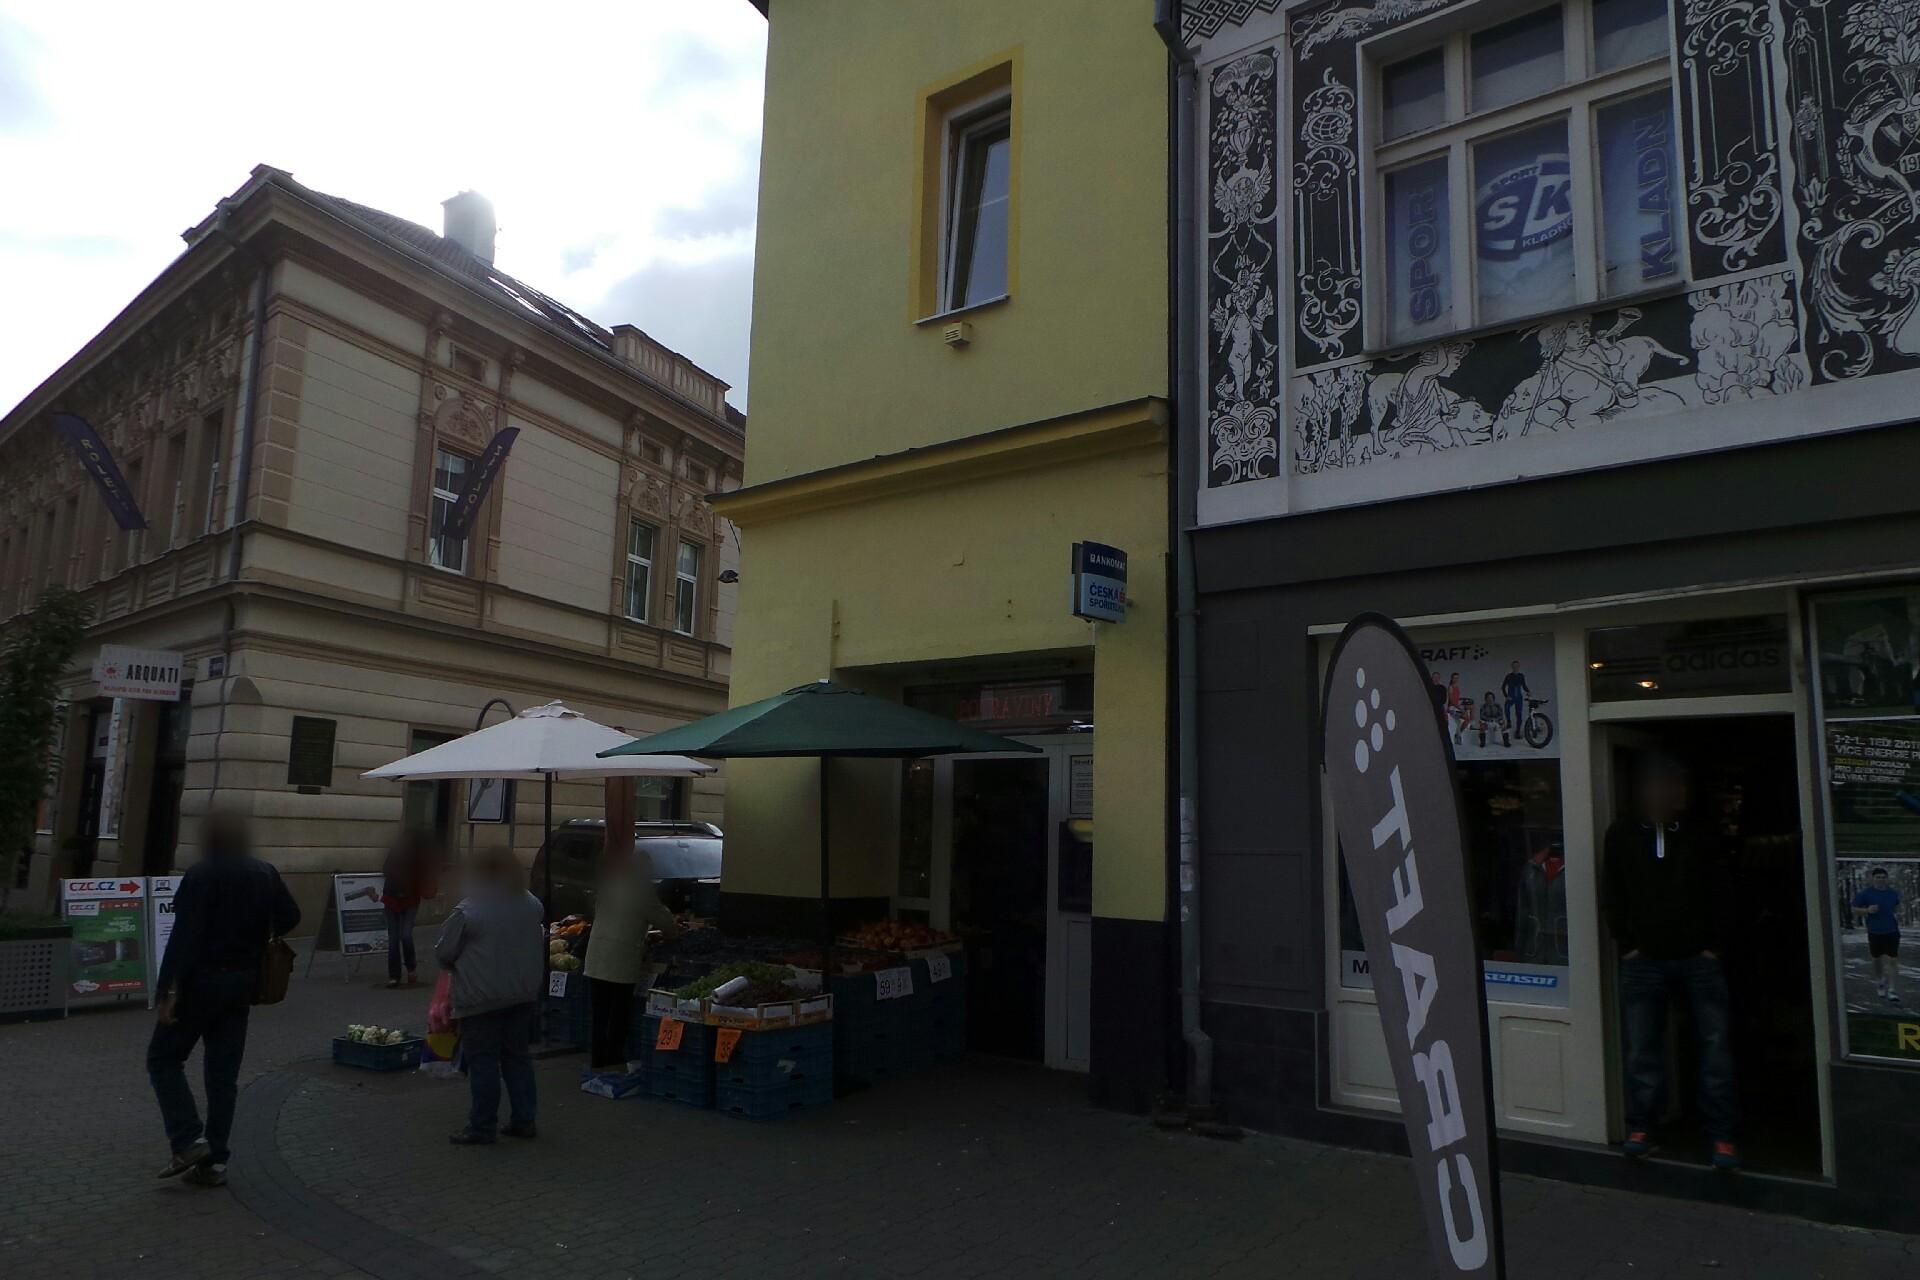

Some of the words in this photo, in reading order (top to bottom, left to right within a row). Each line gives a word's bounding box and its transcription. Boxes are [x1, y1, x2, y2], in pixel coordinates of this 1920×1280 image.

[1633, 110, 1674, 280] KLADN
[1408, 187, 1441, 324] SPOR
[1420, 645, 1471, 661] RAFT
[1666, 647, 1780, 673] adidas
[126, 664, 179, 683] ARQUATI
[70, 881, 115, 892] CZC.CZ
[1352, 959, 1370, 974] M
[1484, 972, 1556, 987] sensor
[1897, 1023, 1920, 1051] R
